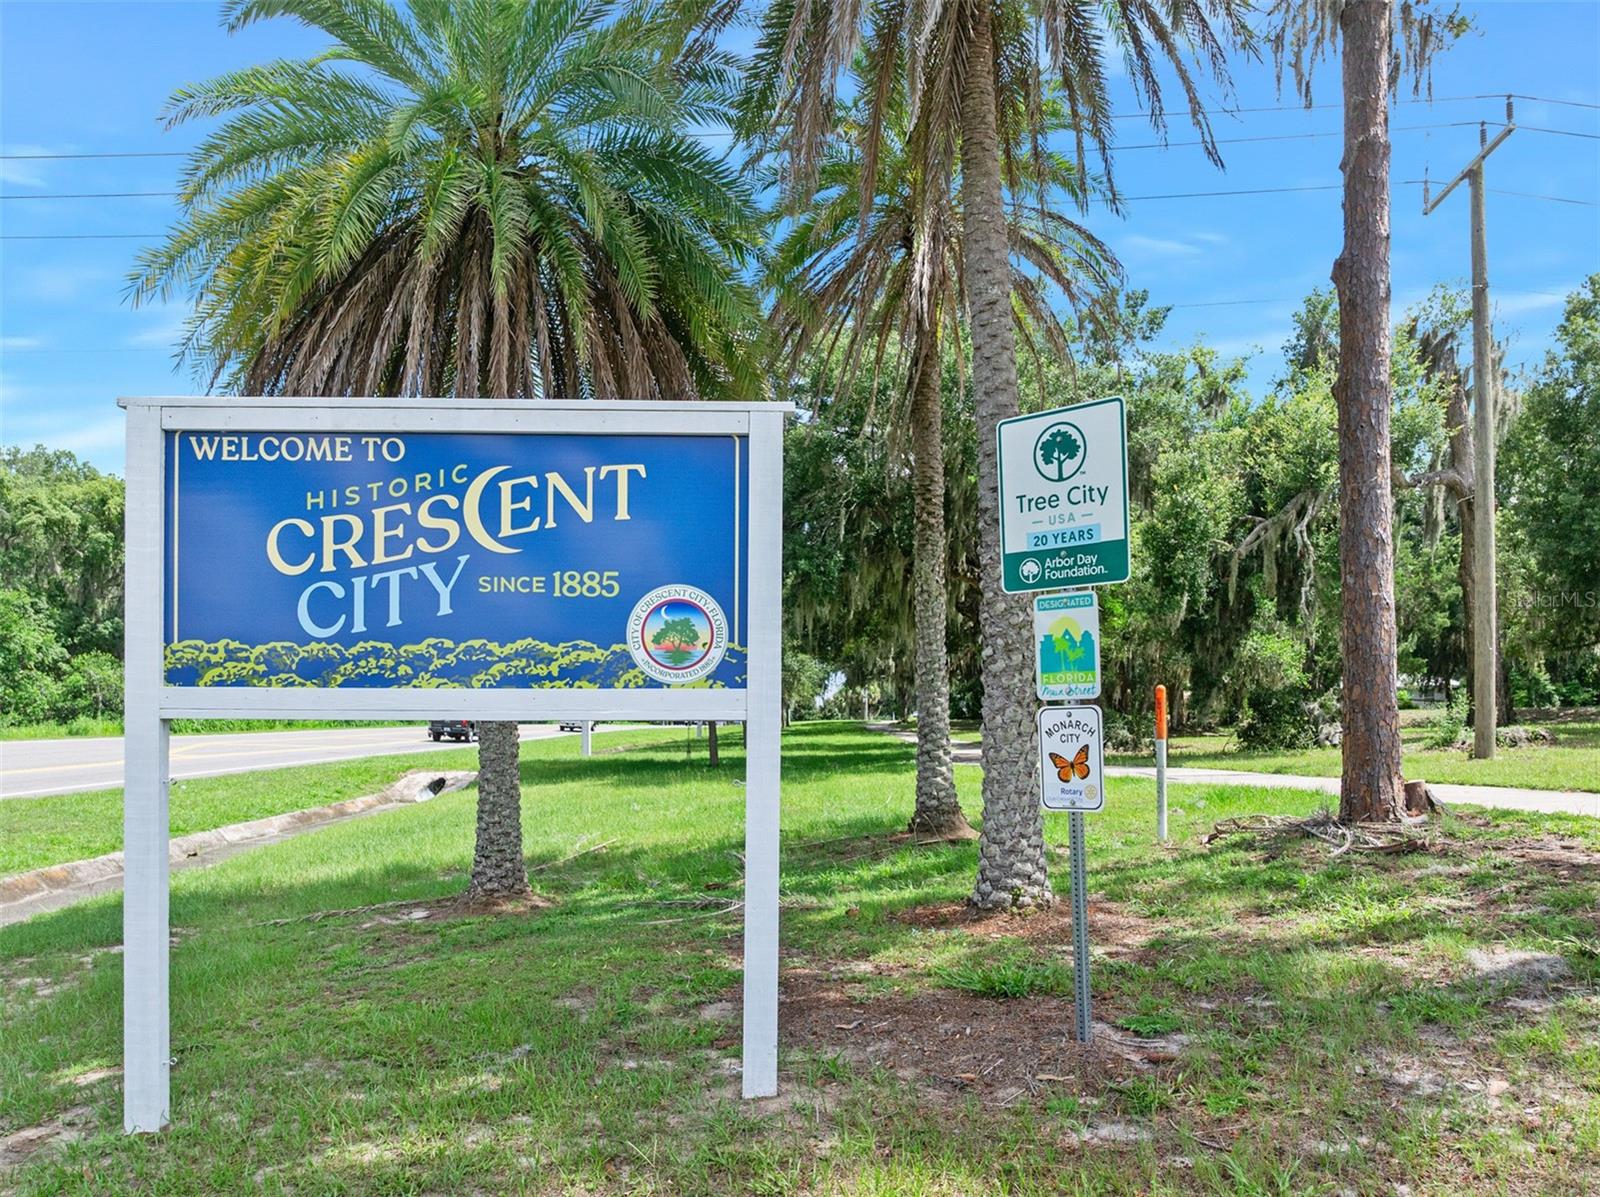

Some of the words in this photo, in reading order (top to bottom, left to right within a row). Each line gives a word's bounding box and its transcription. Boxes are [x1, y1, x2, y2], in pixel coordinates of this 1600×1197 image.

[189, 436, 353, 462] WELCOME
[361, 437, 406, 462] TO
[306, 464, 468, 510] HISTORIC
[1016, 493, 1060, 513] Tree
[1067, 485, 1109, 506] City
[266, 464, 647, 576] CRESCENT
[1048, 512, 1076, 526] USA
[1033, 534, 1048, 547] 20
[1052, 528, 1094, 544] YEARS
[1045, 556, 1075, 569] Arbor
[1077, 553, 1098, 565] Day
[478, 576, 546, 593] SINCE
[552, 571, 620, 597] 1885
[297, 554, 471, 638] CITY
[640, 588, 688, 613] CRESCENT
[632, 612, 643, 626] OF
[709, 607, 724, 649] FLORIDA
[631, 627, 641, 651] CITY
[643, 660, 700, 679] INCORPORATED
[1043, 672, 1094, 685] FLORIDA
[1045, 719, 1096, 739] MONARCH
[1060, 733, 1081, 744] CITY
[1060, 787, 1083, 796] Rotary
